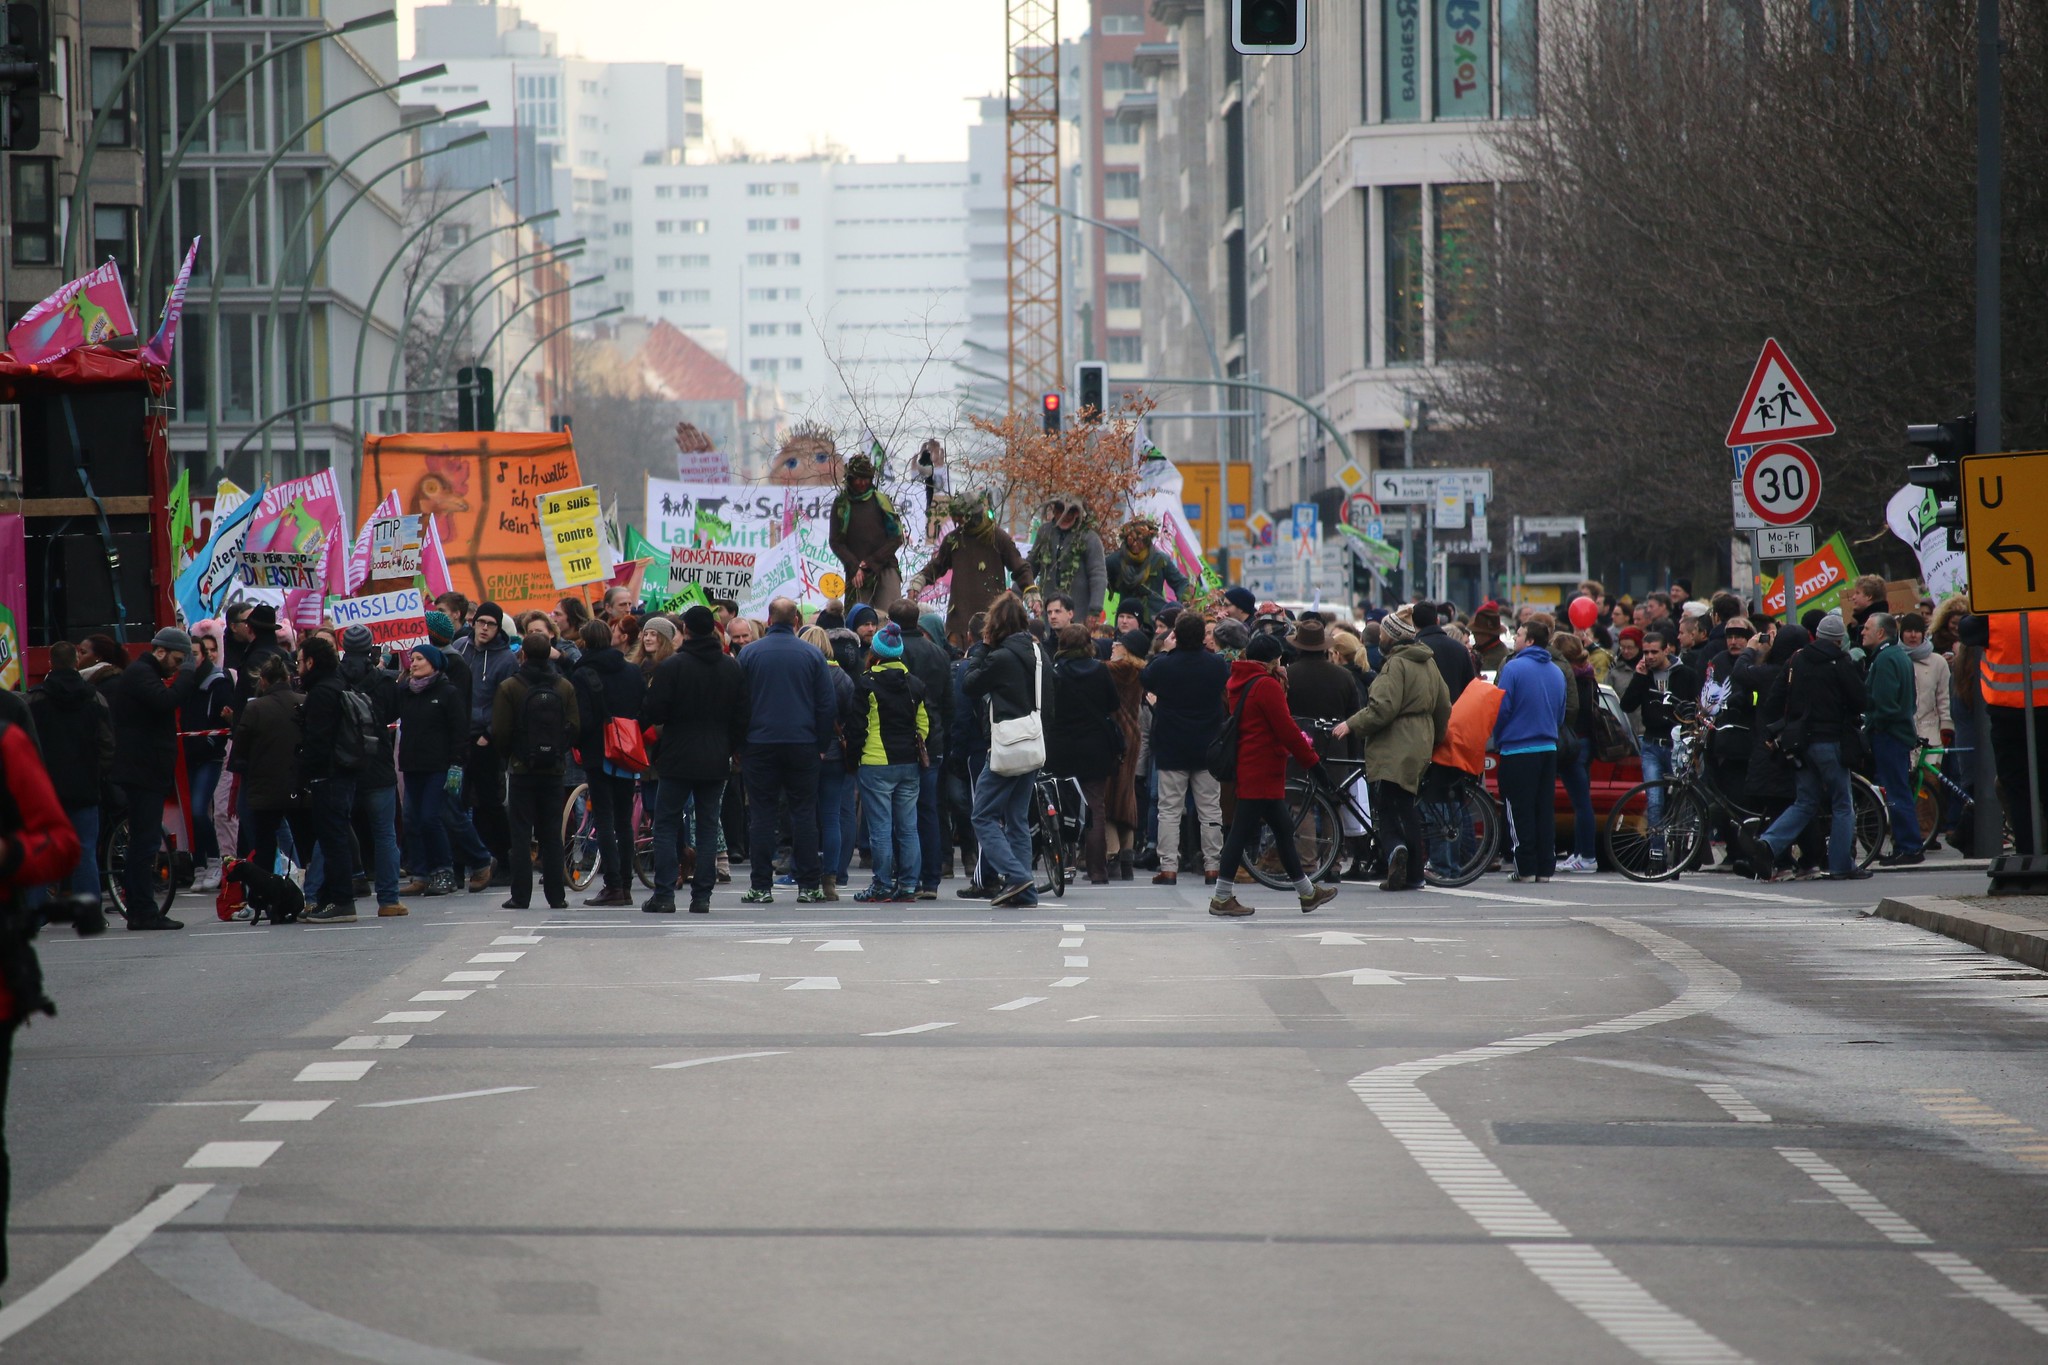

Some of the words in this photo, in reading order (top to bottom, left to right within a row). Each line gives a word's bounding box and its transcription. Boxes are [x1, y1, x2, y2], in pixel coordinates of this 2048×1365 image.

[1402, 18, 1415, 101] BABIES
[1453, 28, 1477, 99] Toys
[518, 465, 538, 486] Ich
[1759, 465, 1804, 503] 30
[263, 472, 332, 515] STOPPEN!
[511, 489, 529, 509] ich
[1979, 475, 2004, 509] U
[549, 501, 560, 515] Je
[567, 496, 590, 511] suis
[373, 519, 400, 541] TTIP
[498, 511, 529, 535] kein
[557, 527, 593, 544] contre
[1768, 532, 1800, 542] Mo-Fr
[243, 553, 260, 564] FÜR
[263, 553, 285, 564] MEHR
[671, 548, 756, 568] MONSATAN&CO
[1770, 545, 1776, 554] 6
[1785, 544, 1793, 553] 18
[240, 562, 315, 589] DIVERSITÄT
[569, 557, 592, 573] TTIP
[487, 570, 529, 588] GRÜNE
[670, 566, 703, 583] NICHT
[706, 571, 721, 585] DIE
[726, 571, 752, 588] TÜR
[333, 592, 419, 624] MASSLOS
